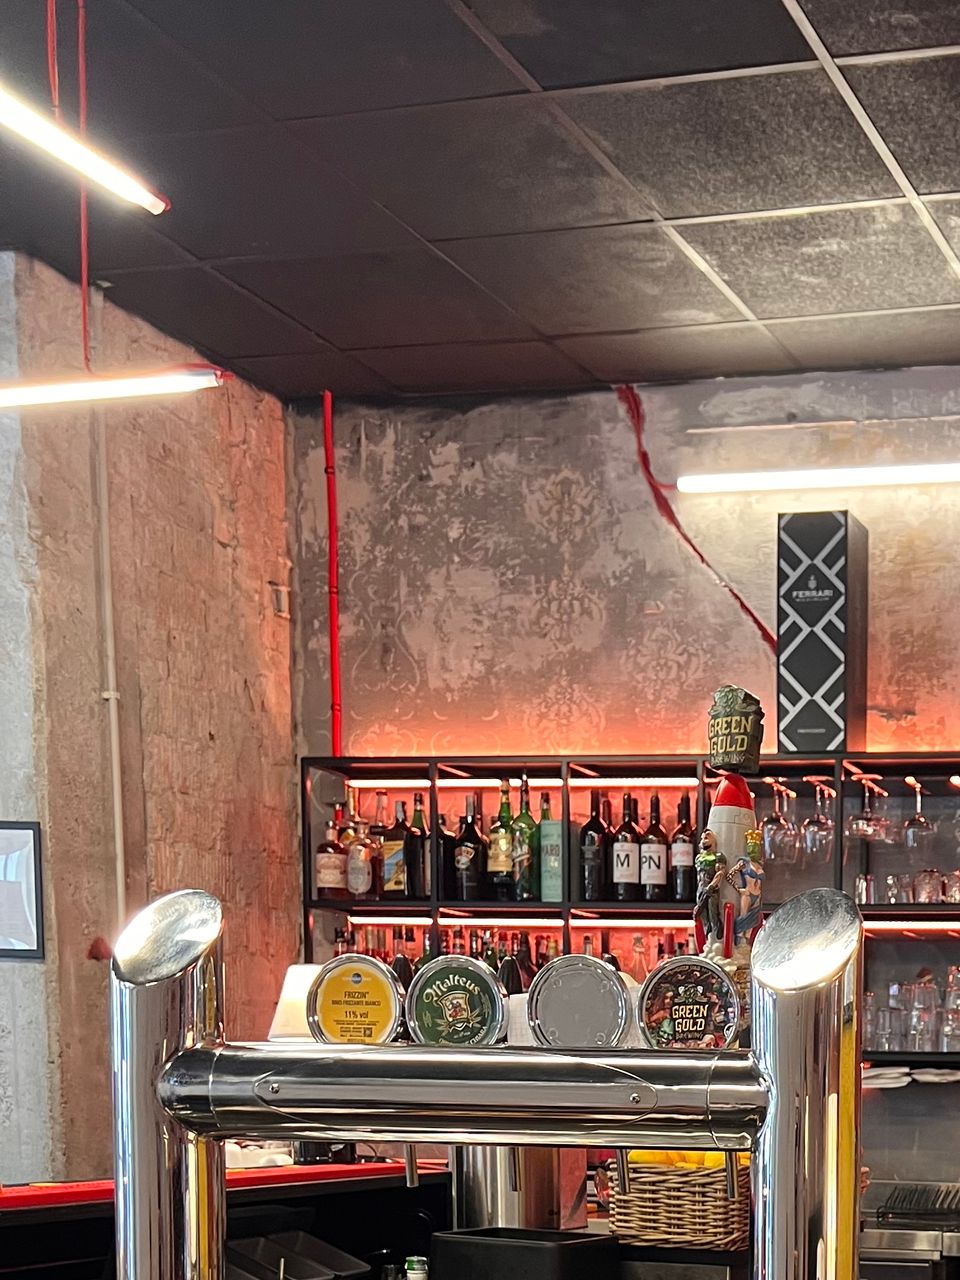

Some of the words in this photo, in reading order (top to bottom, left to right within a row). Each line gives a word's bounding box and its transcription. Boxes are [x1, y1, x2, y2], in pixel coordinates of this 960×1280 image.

[709, 715, 754, 738] GREEN
[711, 735, 748, 757] GOLD
[615, 853, 630, 868] M
[672, 1004, 709, 1018] GREEN
[675, 1018, 705, 1033] GOLD
